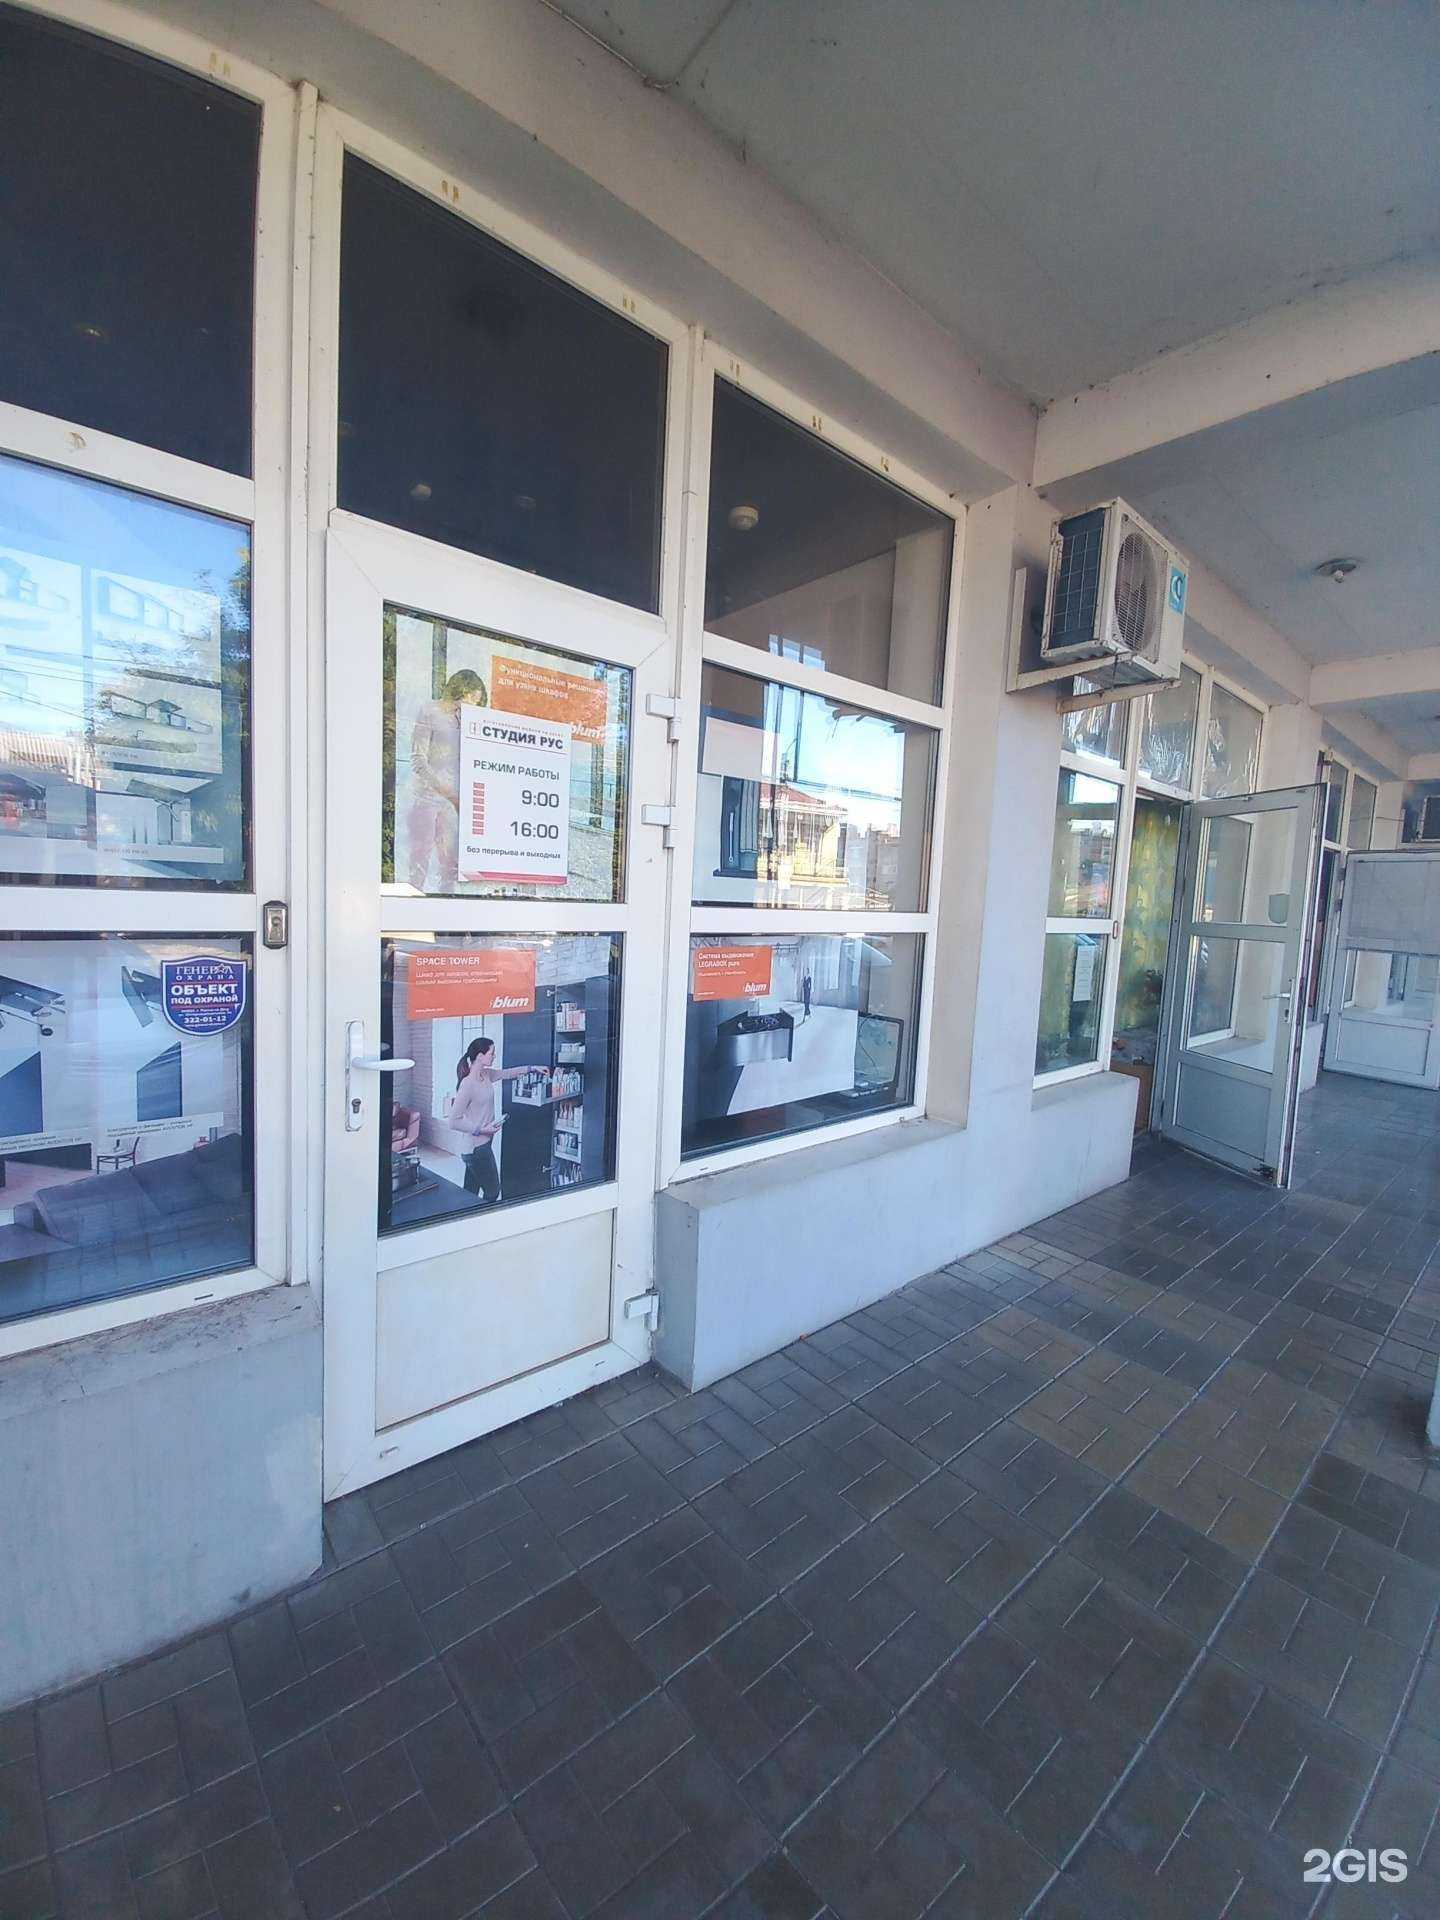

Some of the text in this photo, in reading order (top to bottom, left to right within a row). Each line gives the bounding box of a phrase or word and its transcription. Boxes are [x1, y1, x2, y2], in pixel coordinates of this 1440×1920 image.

[482, 725, 536, 744] СТУДИЯ
[540, 735, 564, 750] РУС
[473, 759, 560, 781] РЕЖИМ РАБОТЫ
[521, 789, 560, 808] 9:00
[510, 821, 559, 840] 16:00
[466, 845, 480, 854] без
[481, 848, 519, 856] перерыва
[526, 851, 560, 859] выходных
[415, 956, 480, 966] SPACE TOWER
[171, 984, 238, 996] ОБЪЕКТ
[744, 982, 767, 993] blum
[170, 994, 239, 1005] ПОД ОХРАНОЙ
[492, 996, 529, 1009] blum
